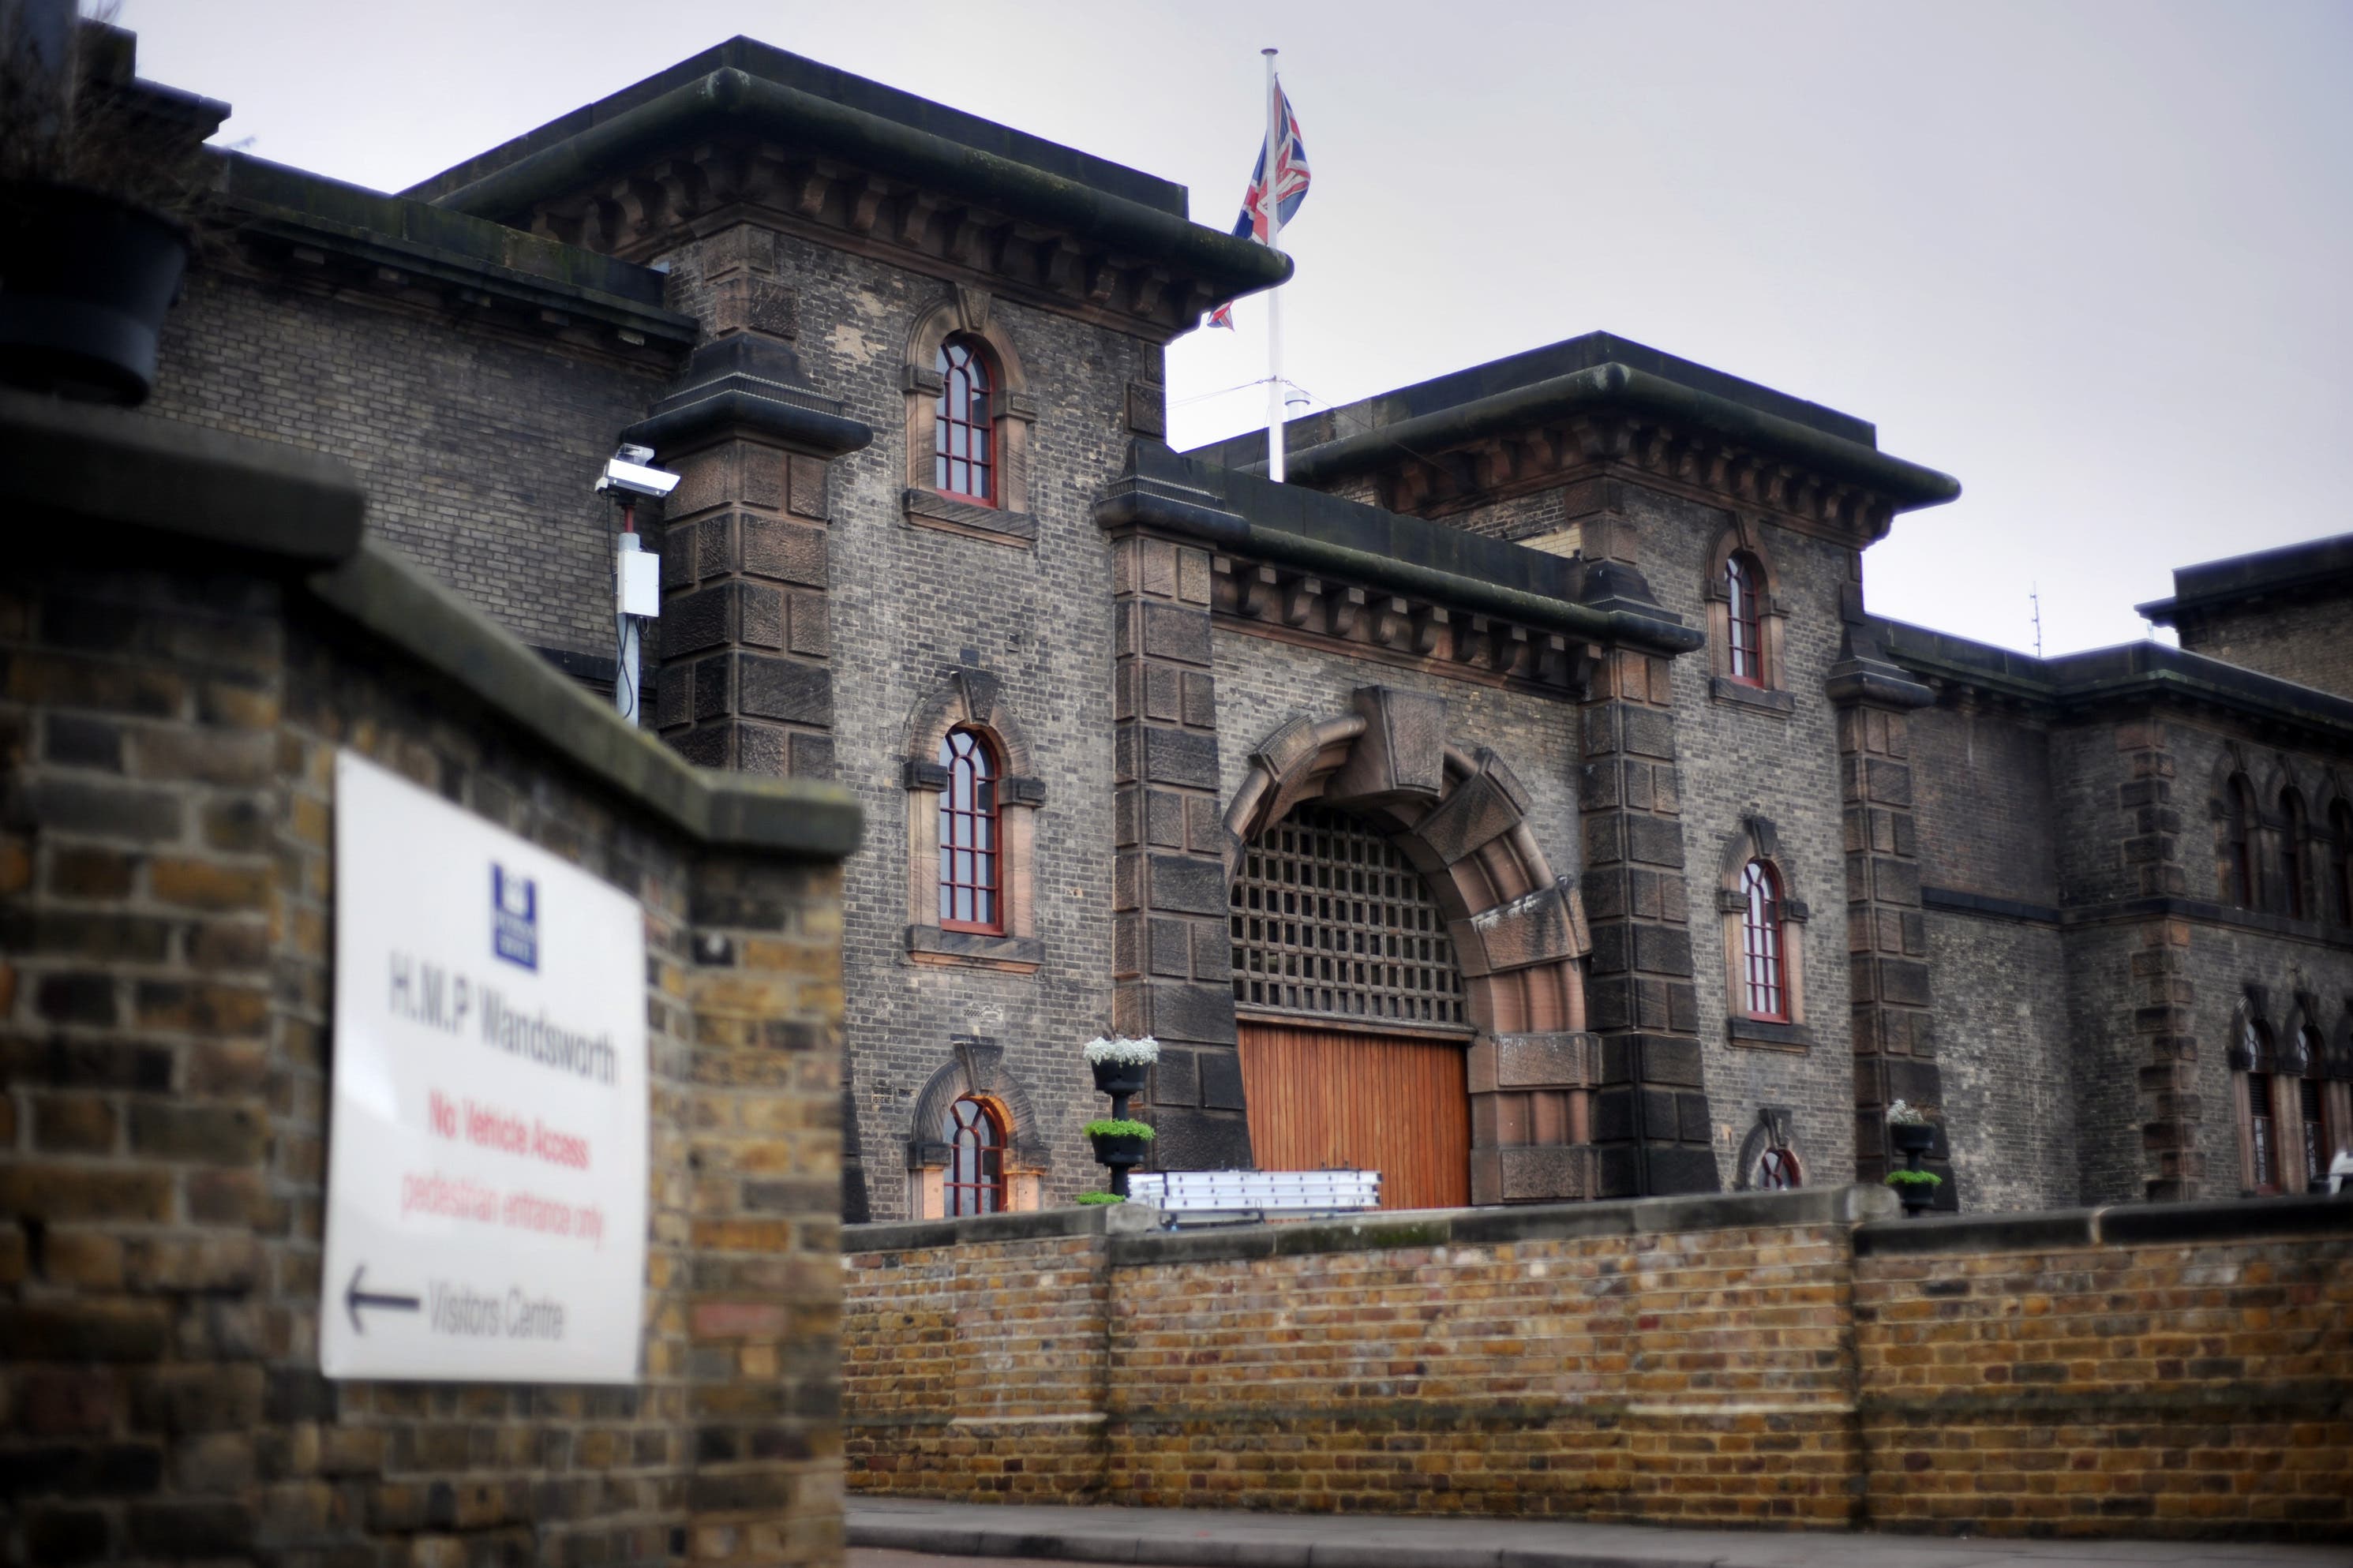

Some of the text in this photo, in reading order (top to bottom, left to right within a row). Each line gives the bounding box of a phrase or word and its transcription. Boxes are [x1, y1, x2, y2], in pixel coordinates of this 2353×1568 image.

[478, 984, 616, 1087] Wandsworth
[428, 1090, 590, 1170] No Vehicle Access
[401, 1170, 604, 1253] pedestrian entrance only
[429, 1277, 564, 1339] Visitors Centre
